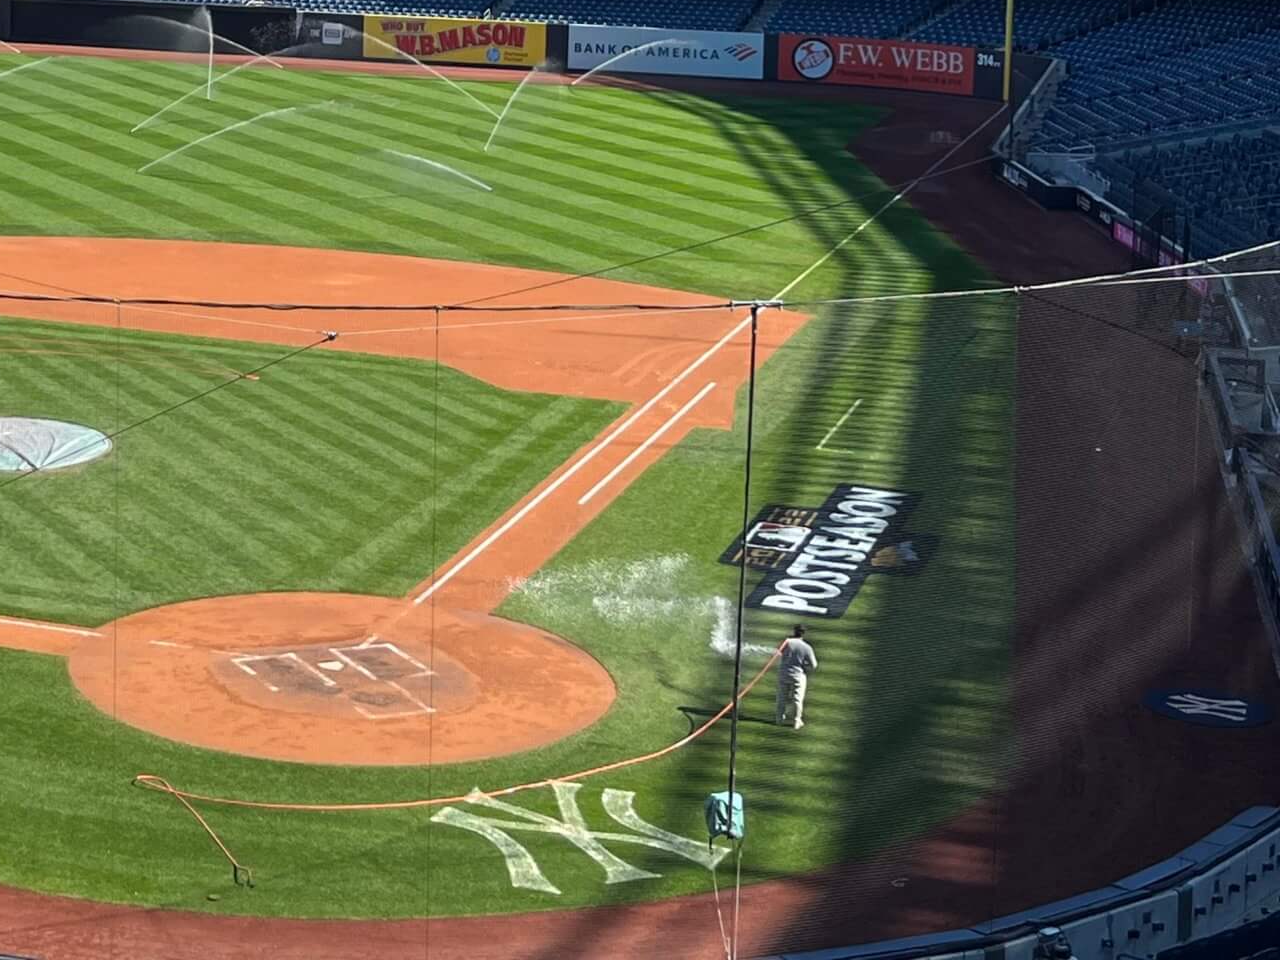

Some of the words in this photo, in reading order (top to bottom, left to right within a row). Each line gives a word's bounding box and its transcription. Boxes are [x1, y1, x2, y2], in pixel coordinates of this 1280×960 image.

[381, 22, 403, 31] WHO
[574, 43, 616, 54] BANK
[647, 46, 720, 59] AMERICA
[891, 46, 964, 74] WEBB
[977, 53, 994, 66] 314
[762, 486, 910, 614] POSTSEASON
